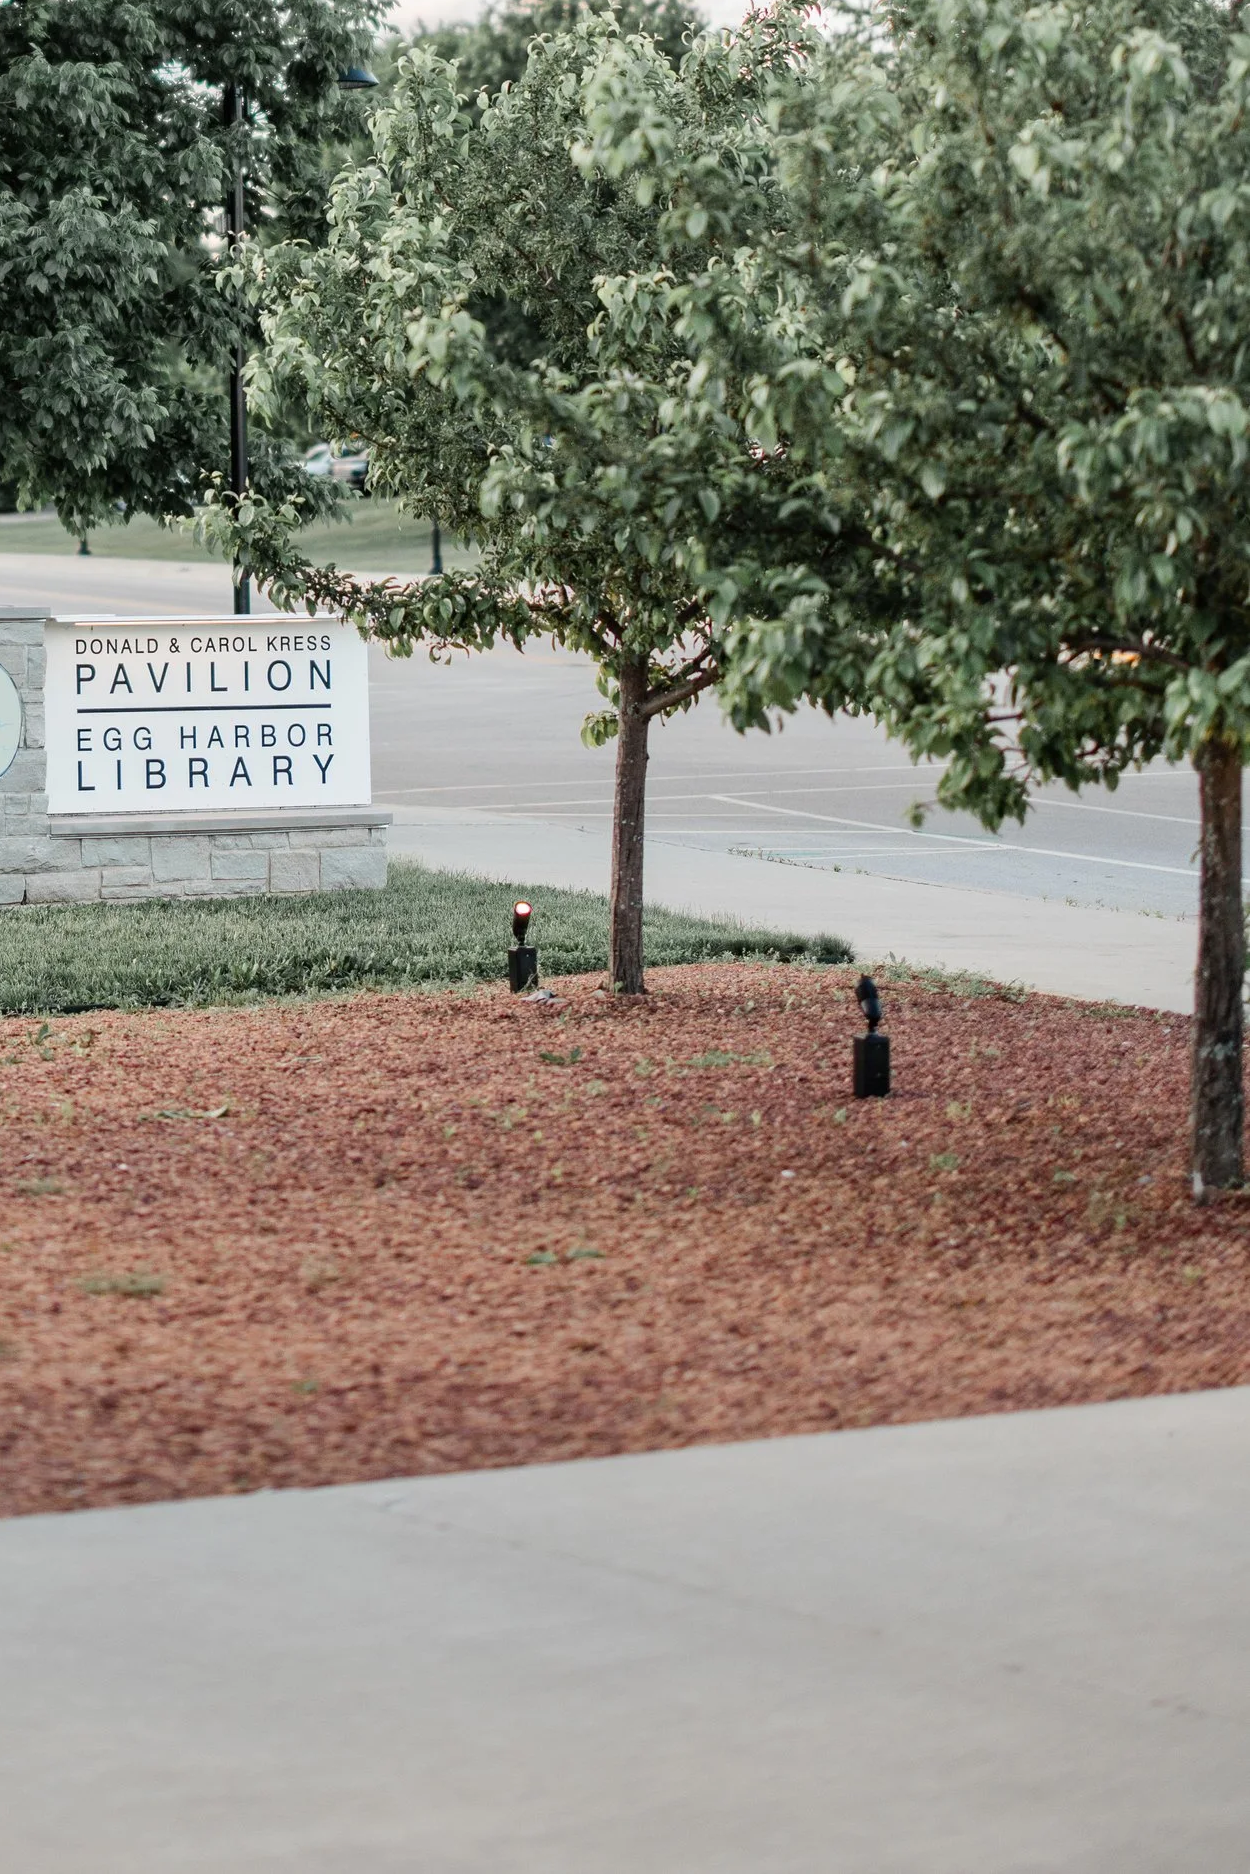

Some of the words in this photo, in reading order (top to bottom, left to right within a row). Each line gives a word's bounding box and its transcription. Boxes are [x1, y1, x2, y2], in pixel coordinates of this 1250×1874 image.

[75, 638, 159, 655] DONALD
[169, 637, 181, 654] &
[190, 636, 258, 654] CAROL
[266, 635, 331, 652] KRESS
[76, 659, 331, 695] PAVILION
[77, 726, 152, 752] EGG
[180, 723, 333, 750] HARBOR
[77, 753, 335, 792] LIBRARY
